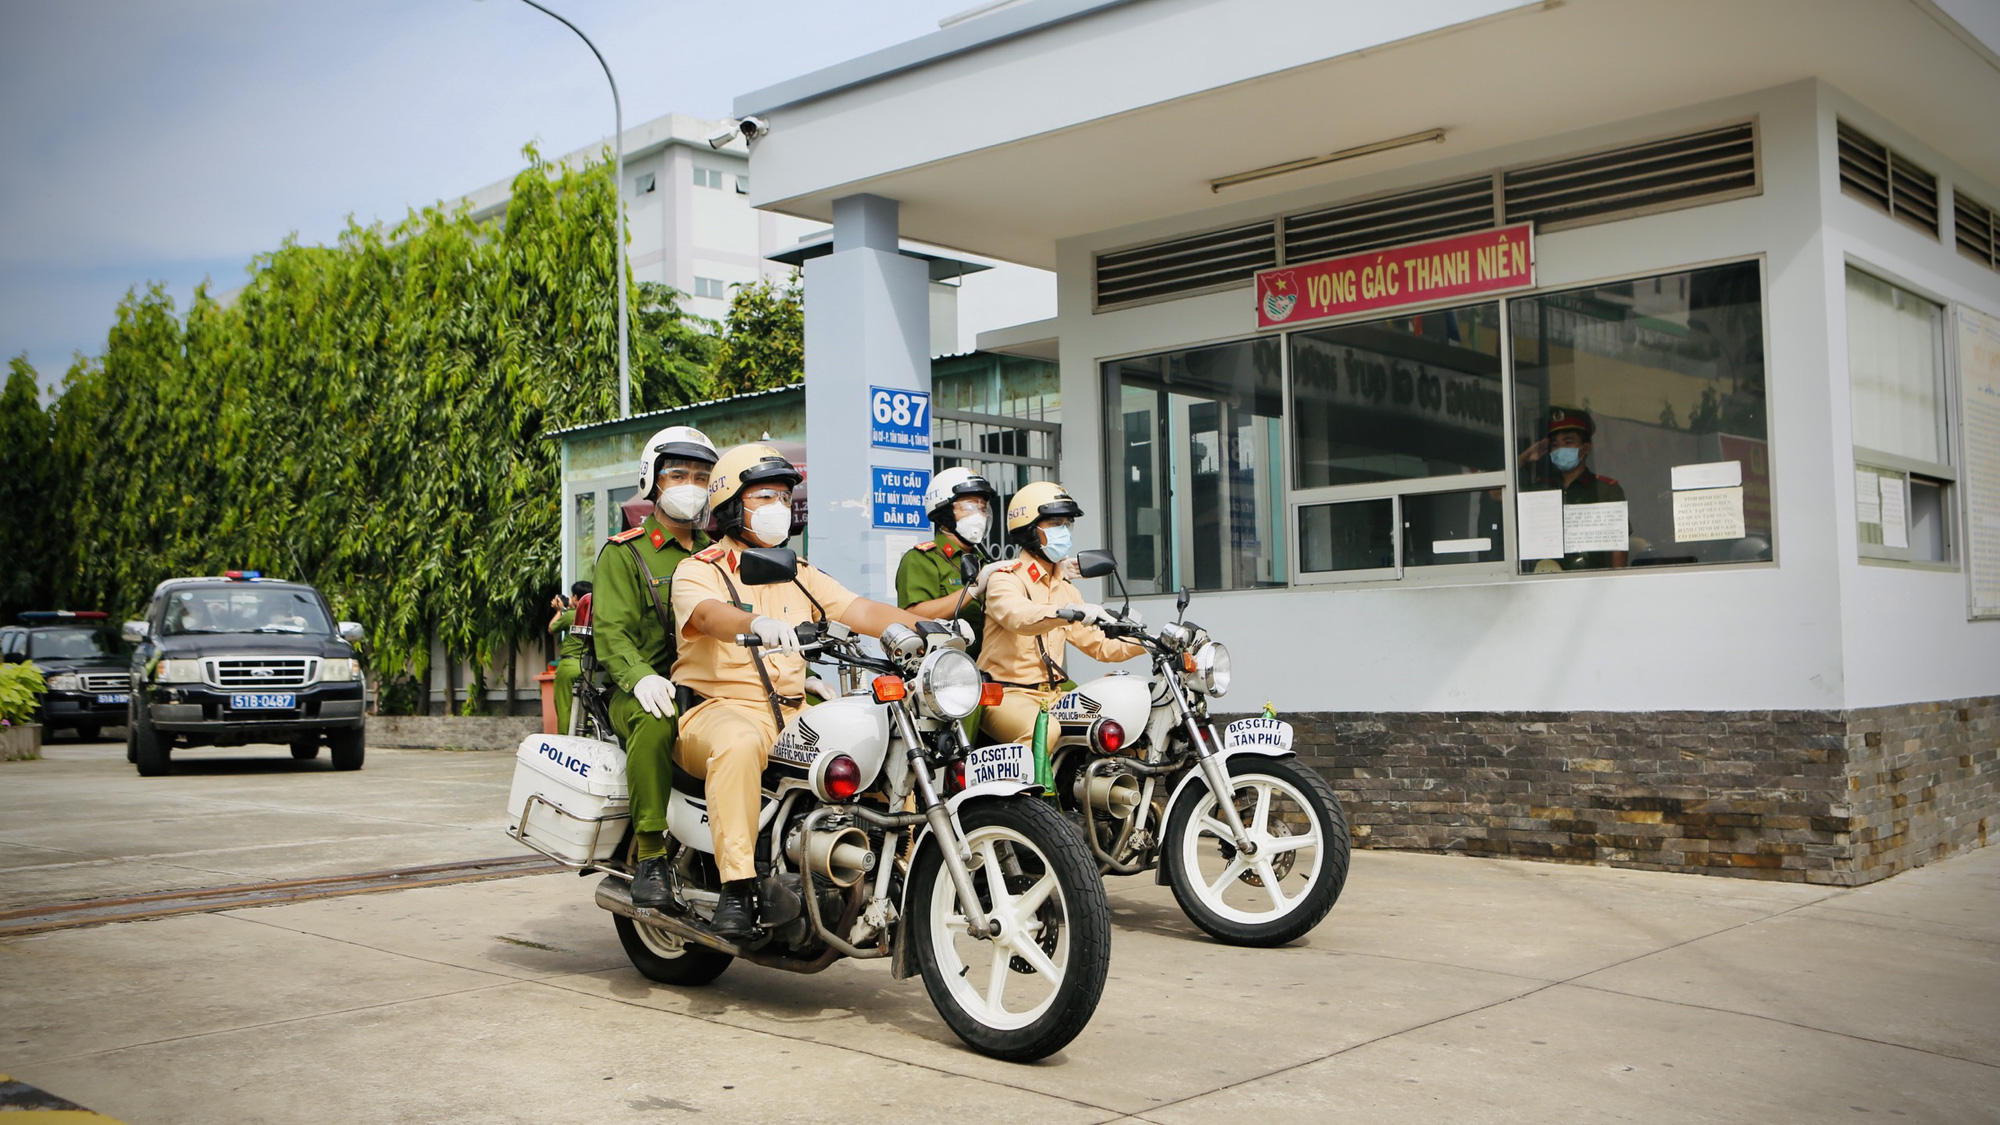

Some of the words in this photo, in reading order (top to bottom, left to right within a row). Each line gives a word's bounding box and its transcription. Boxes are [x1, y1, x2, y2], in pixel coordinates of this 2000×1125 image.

[1307, 270, 1356, 313] VỌNG
[1361, 256, 1399, 299] GÁC
[1404, 250, 1470, 292] THANH
[1477, 234, 1526, 281] NIÊN
[873, 391, 928, 427] 687
[881, 471, 900, 486] YÊU
[903, 471, 921, 488] CẦU
[874, 487, 886, 504] TẮT
[887, 490, 900, 505] MÁY
[901, 490, 921, 506] XUỐNG
[883, 507, 904, 523] DẪN
[906, 510, 920, 527] BỘ
[235, 695, 291, 708] 51B-0487
[1234, 731, 1255, 746] TÂN
[1258, 731, 1281, 746] PHÚ
[539, 742, 591, 778] POLICE
[970, 746, 1023, 766] Đ.CSGT.TT
[974, 763, 995, 783] TÂN
[997, 759, 1020, 778] PHÚ
